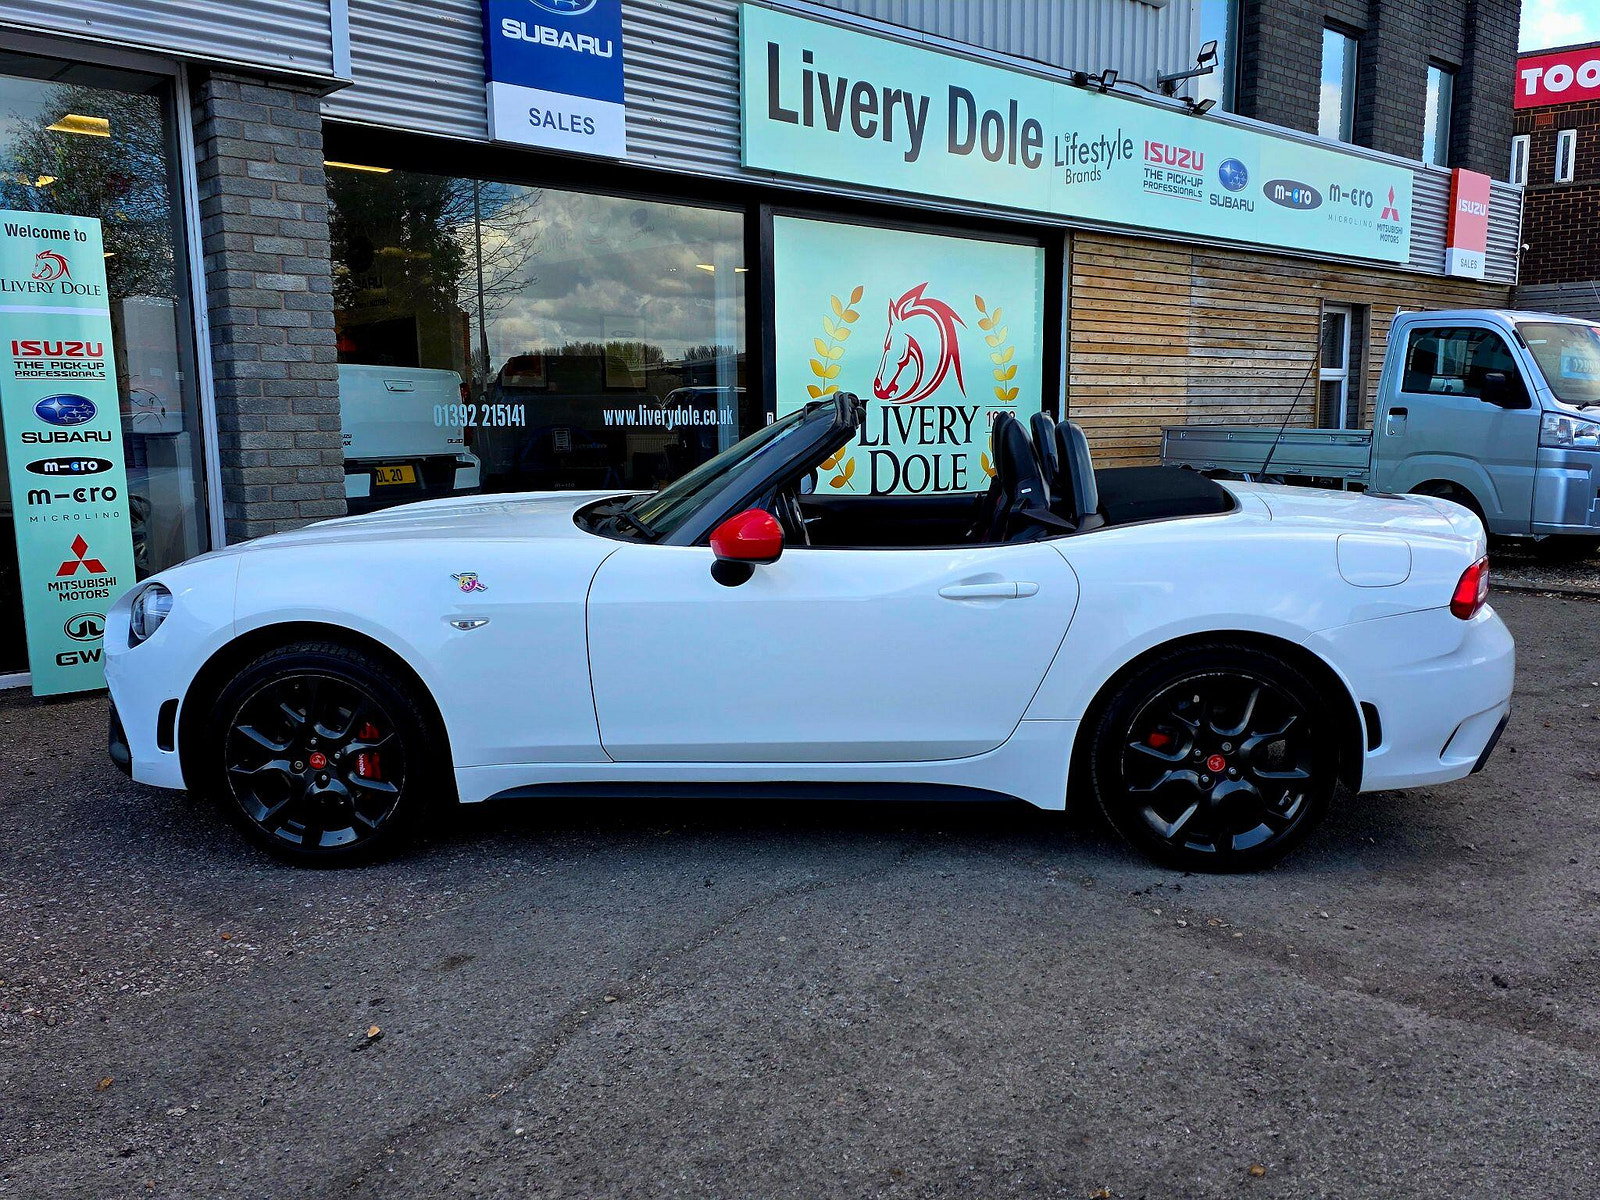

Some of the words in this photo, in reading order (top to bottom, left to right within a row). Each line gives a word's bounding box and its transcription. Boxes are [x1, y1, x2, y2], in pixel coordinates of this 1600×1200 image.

[502, 18, 613, 58] SUBARU
[1521, 59, 1600, 96] TOO
[767, 41, 930, 163] Livery
[947, 84, 1044, 169] Dole
[529, 107, 595, 135] SALES
[1054, 128, 1134, 170] Lifestyle
[1144, 140, 1204, 171] ISUZU
[1065, 165, 1102, 185] Brands
[1144, 168, 1163, 181] THE
[1167, 171, 1203, 188] PICK-UP
[1143, 180, 1203, 198] PROFESSIONALS
[1209, 193, 1255, 213] SUBARU
[1458, 199, 1486, 217] ISUZU
[1328, 213, 1373, 229] MICROLINO
[1376, 222, 1403, 235] MITSUBISHI
[4, 222, 71, 241] Welcome
[74, 228, 87, 242] to
[1379, 234, 1400, 244] MOTORS
[1460, 257, 1478, 270] SALES
[1, 278, 56, 295] LIVERY
[61, 281, 102, 296] DOLE
[11, 340, 104, 357] ISUZU
[14, 360, 44, 370] THE
[51, 360, 105, 370] PICK-UP
[14, 369, 106, 378] PROFESSIONALS
[433, 403, 478, 427] 01392
[481, 403, 526, 427] 215141
[603, 404, 733, 431] www.liverydole.co.uk
[857, 399, 981, 447] LIVERY
[21, 431, 112, 444] SUBARU
[390, 469, 404, 482] 20
[868, 449, 968, 495] DOLE
[30, 511, 120, 523] MICROLINO
[48, 576, 117, 592] MITSUBISHI
[59, 589, 109, 602] MOTORS
[56, 648, 103, 667] GW
